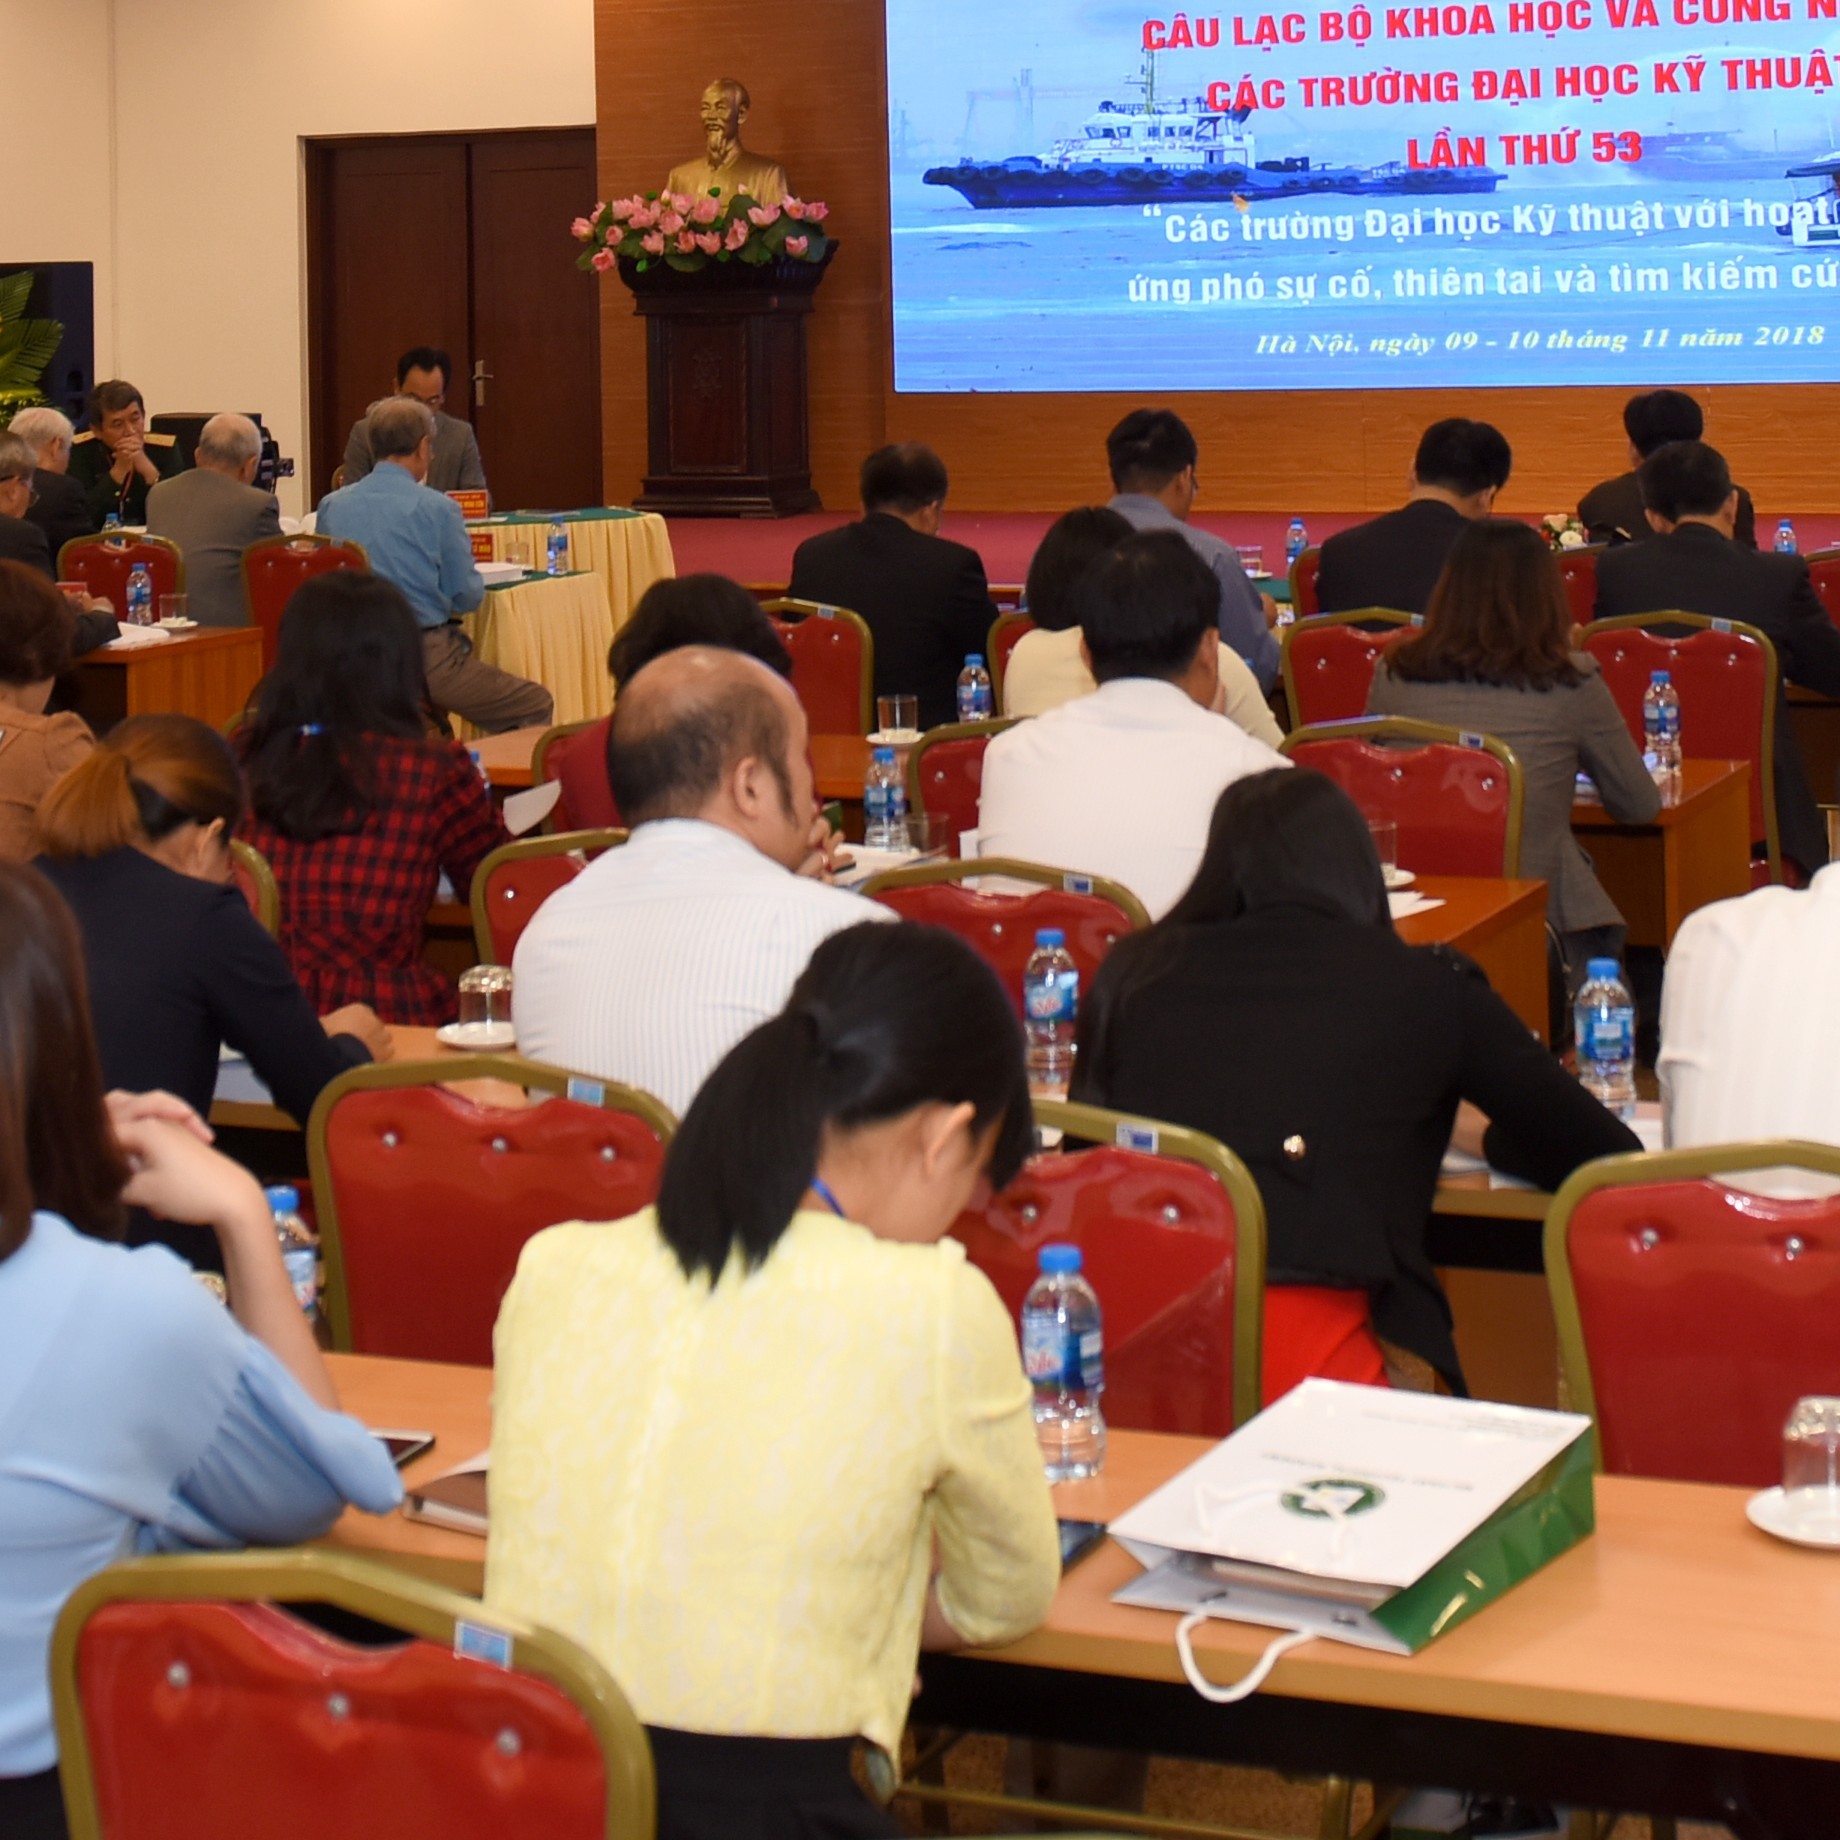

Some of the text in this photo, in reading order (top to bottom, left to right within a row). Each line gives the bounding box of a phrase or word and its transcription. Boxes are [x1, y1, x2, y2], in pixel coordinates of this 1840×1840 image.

[1142, 12, 1220, 50] CÂU
[1233, 13, 1306, 52] LẠC
[1320, 3, 1372, 47] BỘ
[1386, 4, 1496, 39] KHOA
[1509, 0, 1592, 39] HỌC
[1207, 73, 1286, 112] CÁC
[1298, 67, 1459, 107] TRƯỜNG
[1472, 68, 1541, 106] ĐẠI
[1555, 63, 1639, 103] HỌC
[1654, 54, 1706, 94] KỸ
[1407, 126, 1643, 170] LẦN THỨ 53
[1241, 210, 1355, 243] trường
[1365, 207, 1423, 243] Đại
[1434, 205, 1502, 242] học
[1513, 202, 1557, 236] Kỹ
[1569, 200, 1666, 237] thuật
[1674, 195, 1730, 229] với
[1744, 195, 1829, 231] hoạt
[1128, 272, 1191, 305] ứng
[1201, 272, 1265, 305] phó
[1276, 271, 1317, 305] sự
[1328, 265, 1384, 301] cố,
[1393, 266, 1485, 297] thiên
[1495, 265, 1542, 295] tai
[1555, 263, 1596, 293] và
[1608, 261, 1669, 293] tìm
[1682, 254, 1778, 290] kiếm
[1255, 334, 1297, 355] Hà
[1305, 332, 1361, 357] Nội,
[1369, 334, 1435, 358] ngày
[1444, 331, 1479, 350] 09
[1507, 330, 1540, 350] 10
[1546, 328, 1628, 353] tháng
[1640, 328, 1669, 348] 11
[1679, 328, 1744, 348] năm
[1754, 326, 1826, 347] 2018
